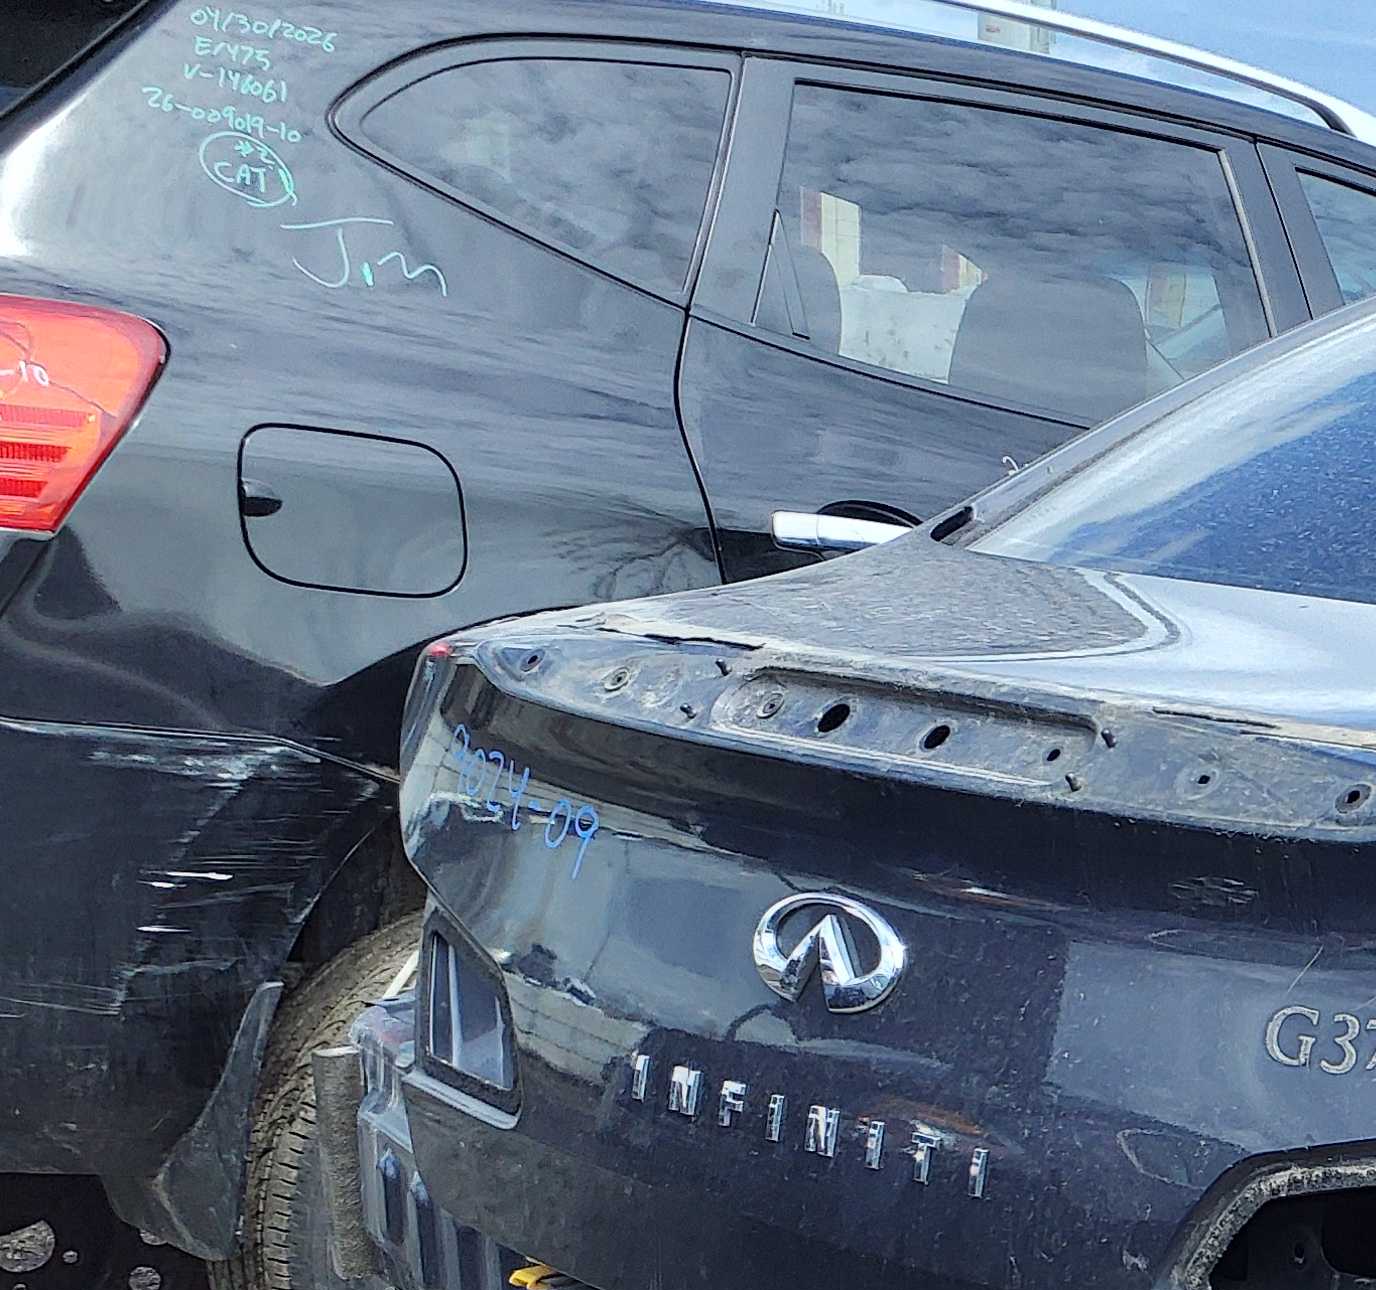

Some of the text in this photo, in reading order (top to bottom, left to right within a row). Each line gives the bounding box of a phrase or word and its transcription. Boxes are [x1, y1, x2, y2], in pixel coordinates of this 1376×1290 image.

[191, 6, 338, 53] 04/30/2026
[214, 161, 269, 193] CAT
[280, 216, 449, 297] Jim
[453, 723, 600, 880] 9024-09
[630, 1054, 991, 1199] INFINITI
